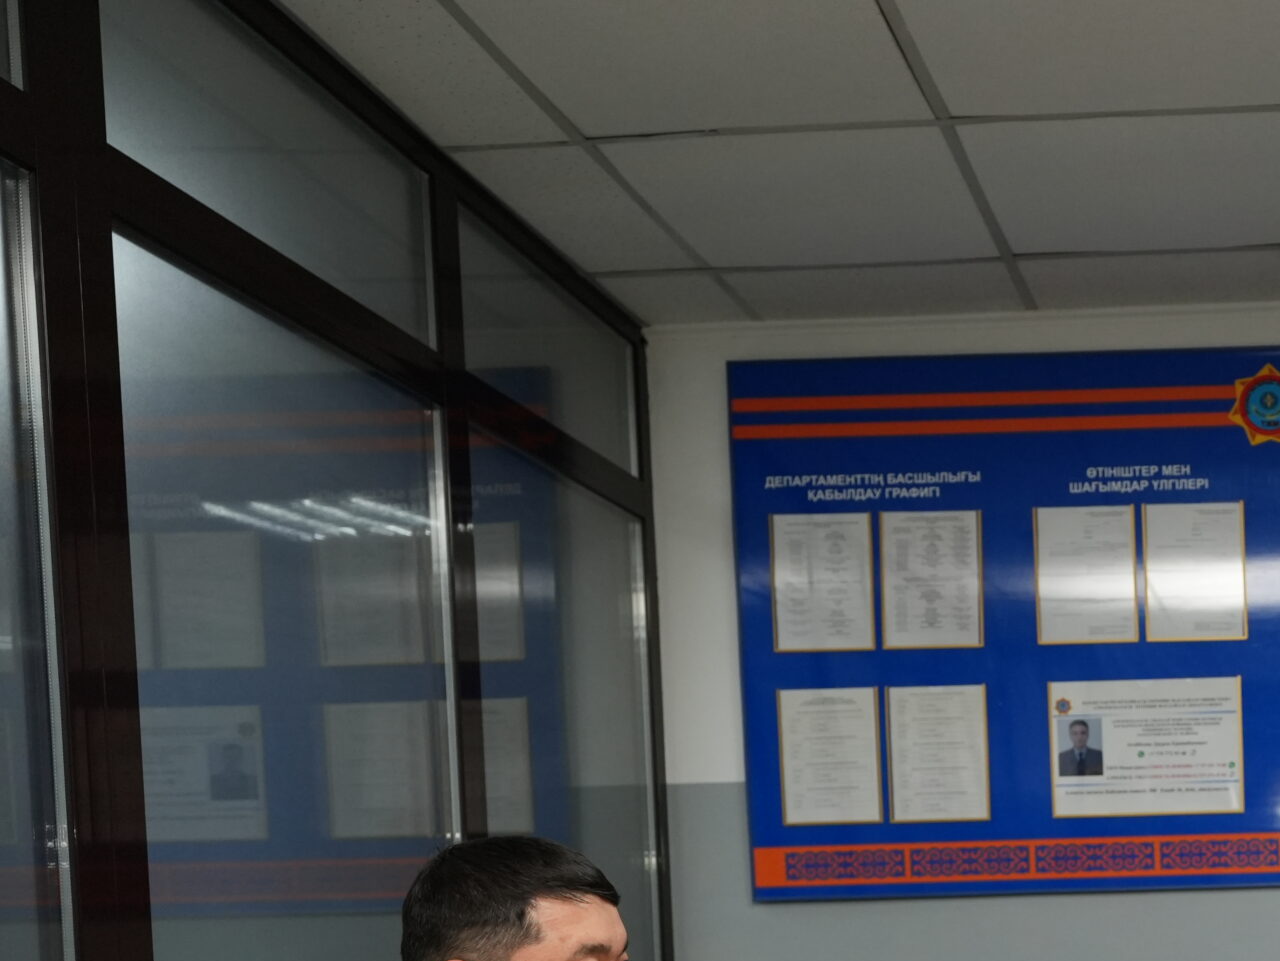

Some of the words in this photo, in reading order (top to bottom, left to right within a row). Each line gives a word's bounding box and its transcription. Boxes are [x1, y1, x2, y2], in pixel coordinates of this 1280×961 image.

[765, 473, 885, 488] ДЕПАРТАМЕНТТІҢ
[887, 471, 982, 485] БАСШЫЛЫҒЫ
[1086, 465, 1159, 479] ӨТІНІШТЕР
[1162, 464, 1191, 477] МЕН
[807, 487, 882, 502] ҚАБЫЛДАУ
[885, 485, 941, 499] ГРАФИГІ
[1069, 479, 1149, 494] ШАҒЫМДАР
[1151, 478, 1209, 491] ҮЛГІЛЕРІ
